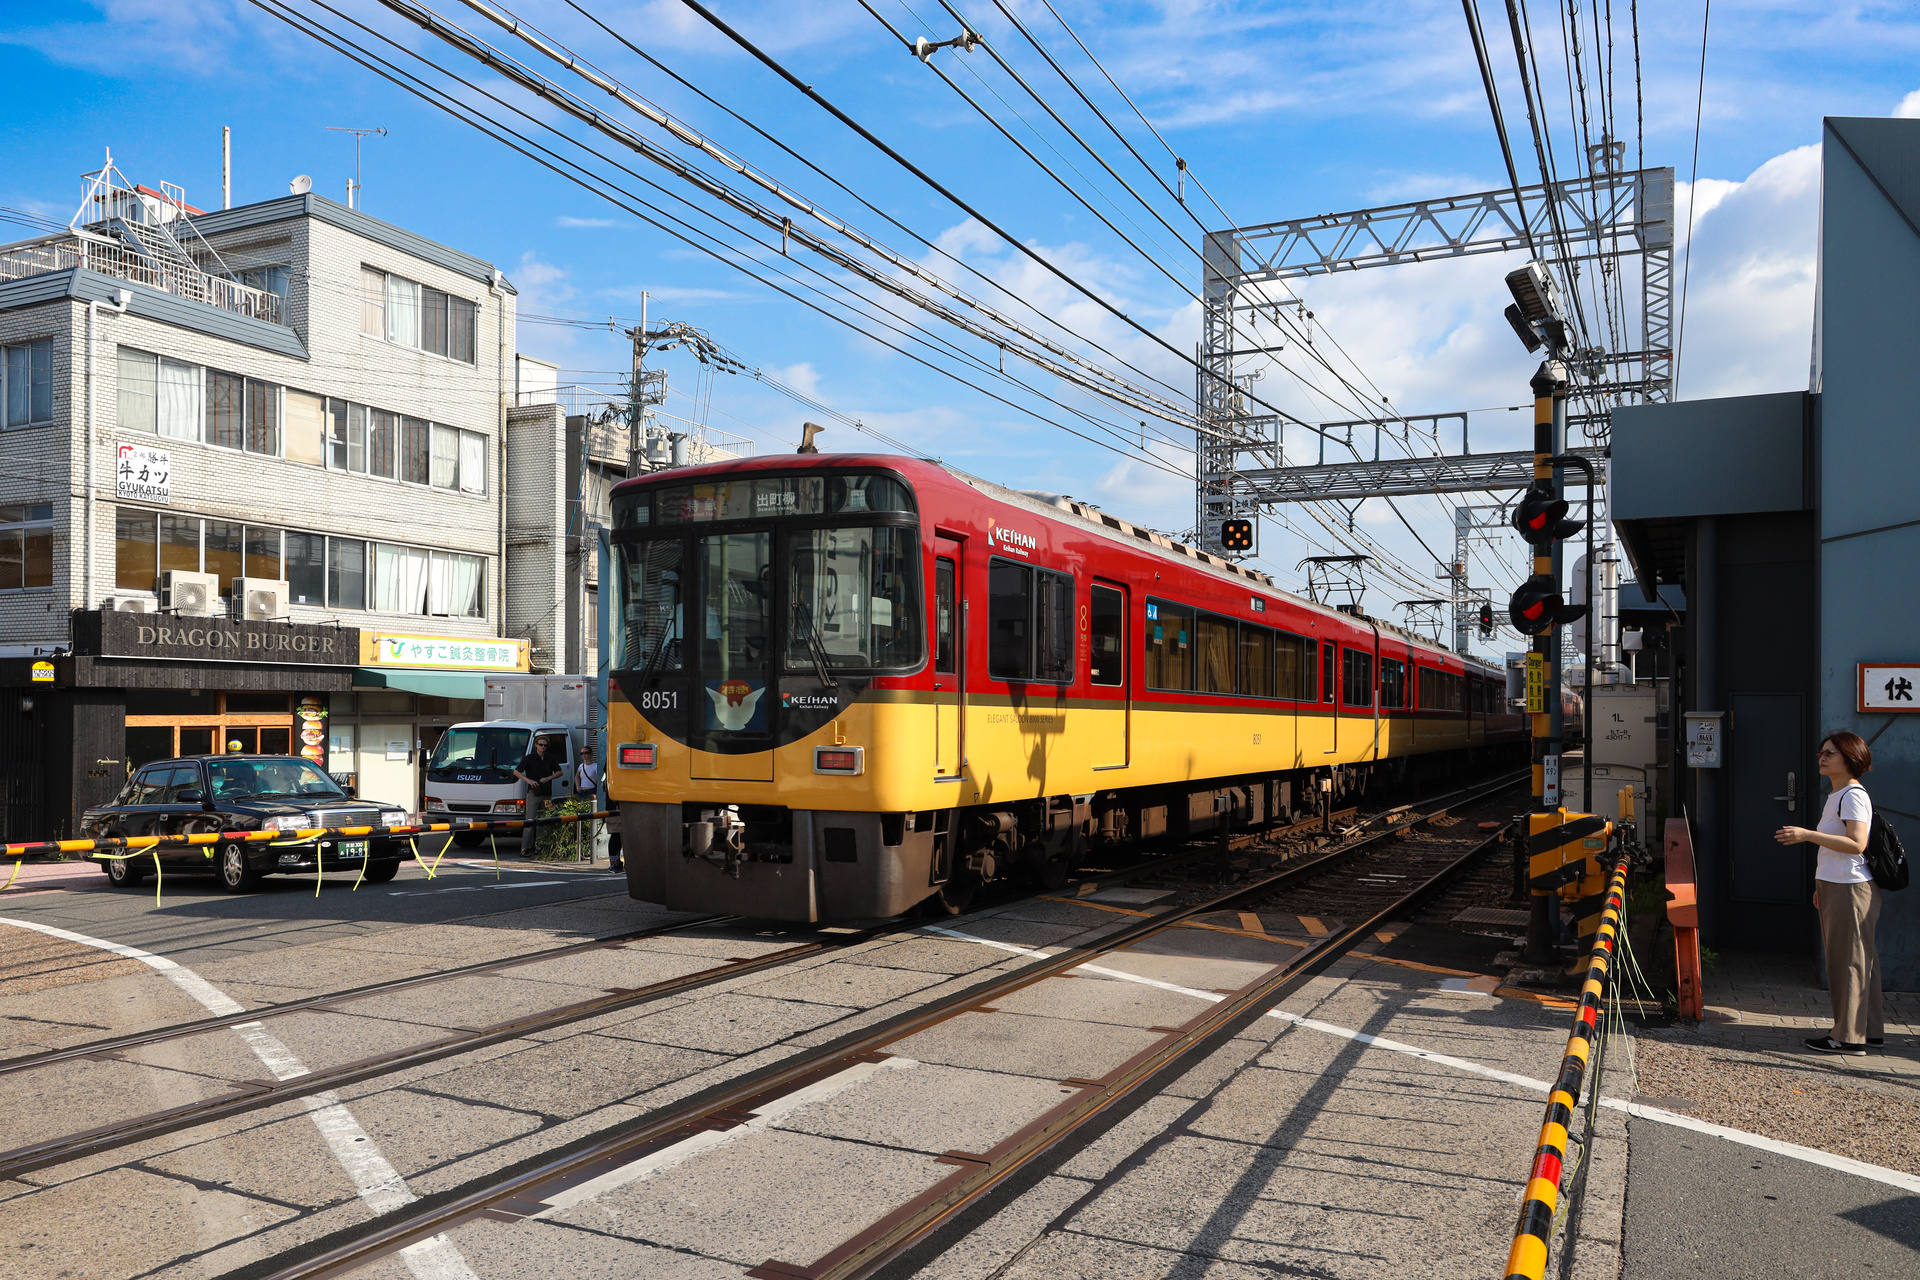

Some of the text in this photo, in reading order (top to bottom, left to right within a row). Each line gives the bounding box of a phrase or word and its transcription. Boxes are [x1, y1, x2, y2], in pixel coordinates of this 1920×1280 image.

[119, 460, 168, 484] 牛カツ
[118, 481, 168, 496] GYUKATSU
[118, 490, 138, 498] KYOTO
[686, 497, 717, 512] 特急
[756, 491, 796, 507] 出町柳
[995, 526, 1036, 550] KEIHAN
[1079, 604, 1088, 631] 8
[136, 625, 335, 653] DRAGON BURGER
[410, 644, 510, 663] やすこ鍼灸整骨院
[1528, 656, 1542, 668] Danger
[721, 685, 749, 695] 特急
[1884, 676, 1913, 702] 伏
[642, 691, 678, 709] 8051
[791, 696, 838, 704] KEIHAN
[987, 714, 1054, 724] ELEGANT SALOON 8000 SERIES
[1611, 713, 1625, 723] 1L
[1546, 767, 1557, 776] ボタン
